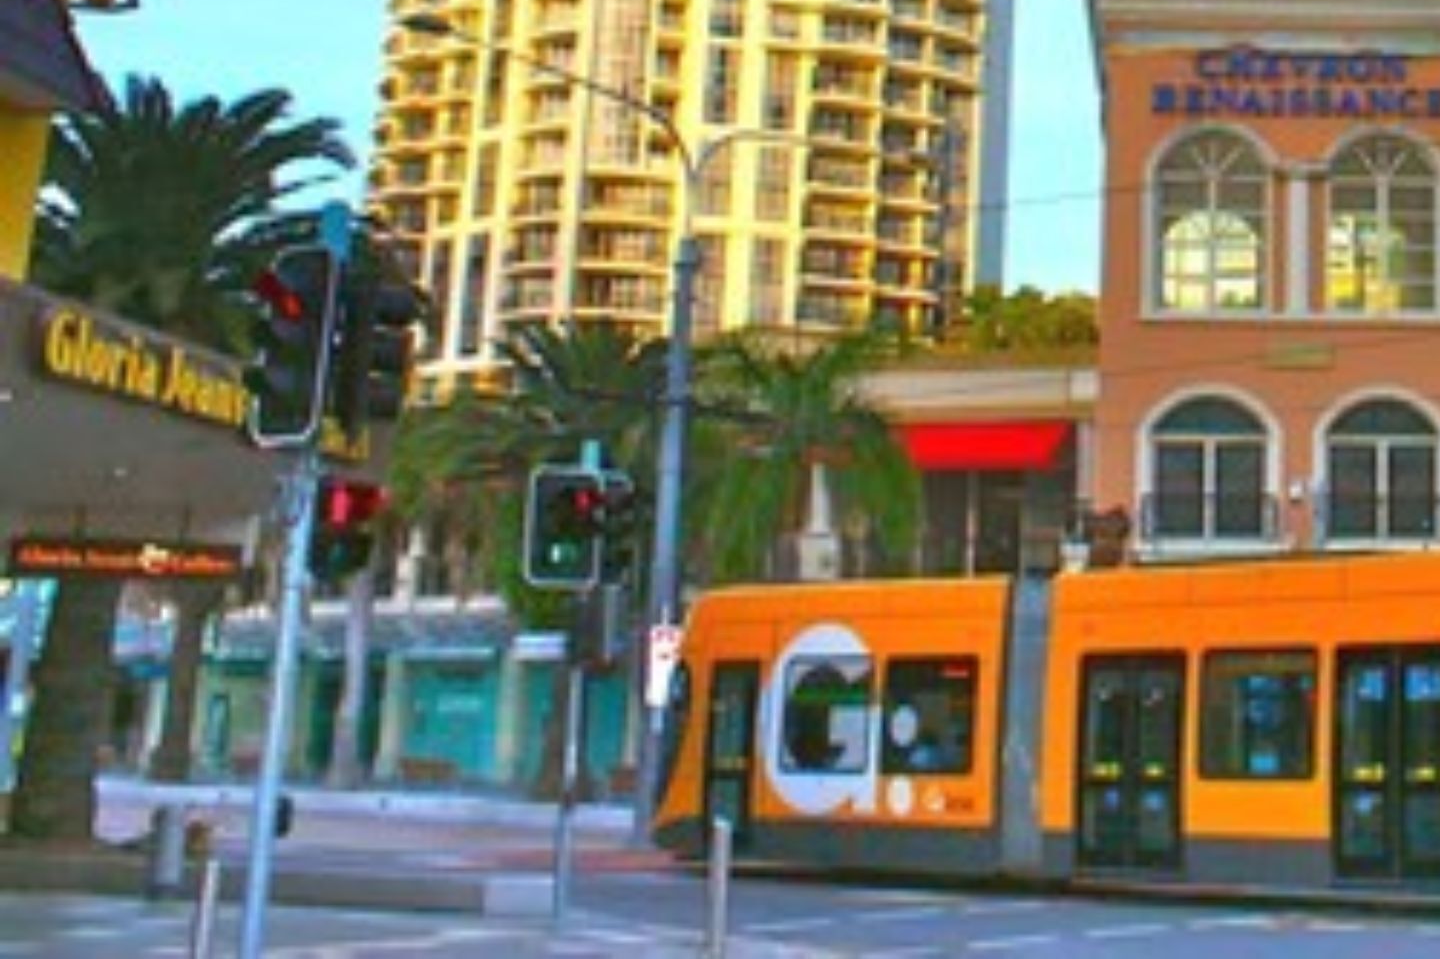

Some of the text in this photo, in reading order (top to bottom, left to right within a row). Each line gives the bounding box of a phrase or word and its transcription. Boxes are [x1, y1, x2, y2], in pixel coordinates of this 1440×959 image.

[1196, 46, 1407, 78] CHEVRON
[46, 308, 250, 425] Gloria Jean
